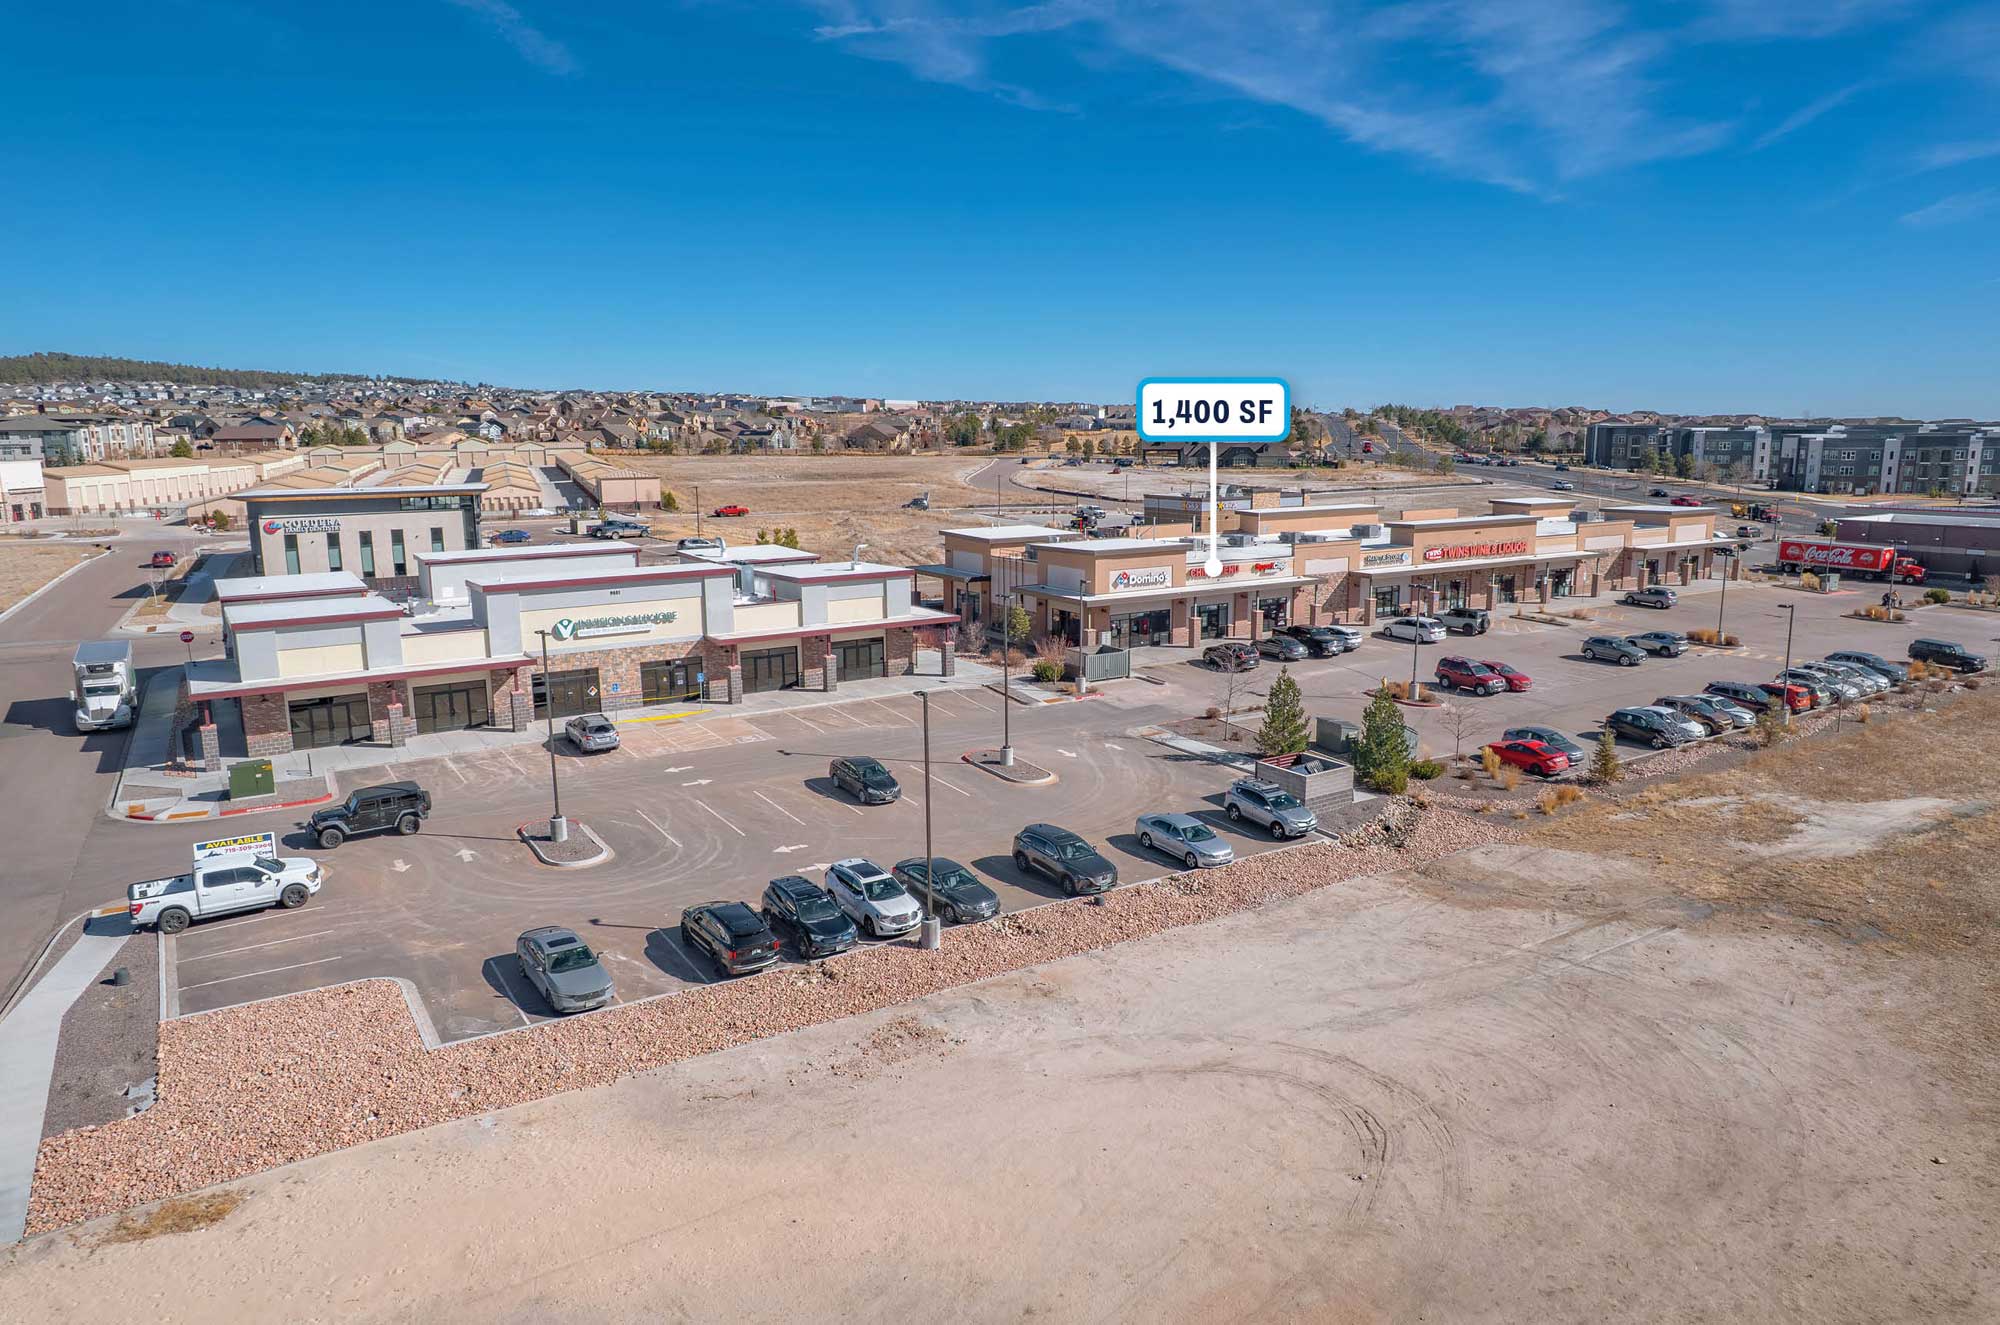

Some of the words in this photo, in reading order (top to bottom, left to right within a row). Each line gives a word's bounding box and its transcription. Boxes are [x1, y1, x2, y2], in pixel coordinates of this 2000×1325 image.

[1499, 542, 1527, 554] LIQUOR
[1805, 546, 1855, 564] Coca-Cola
[1130, 570, 1169, 584] Domino's
[206, 835, 263, 849] AVAILABLE
